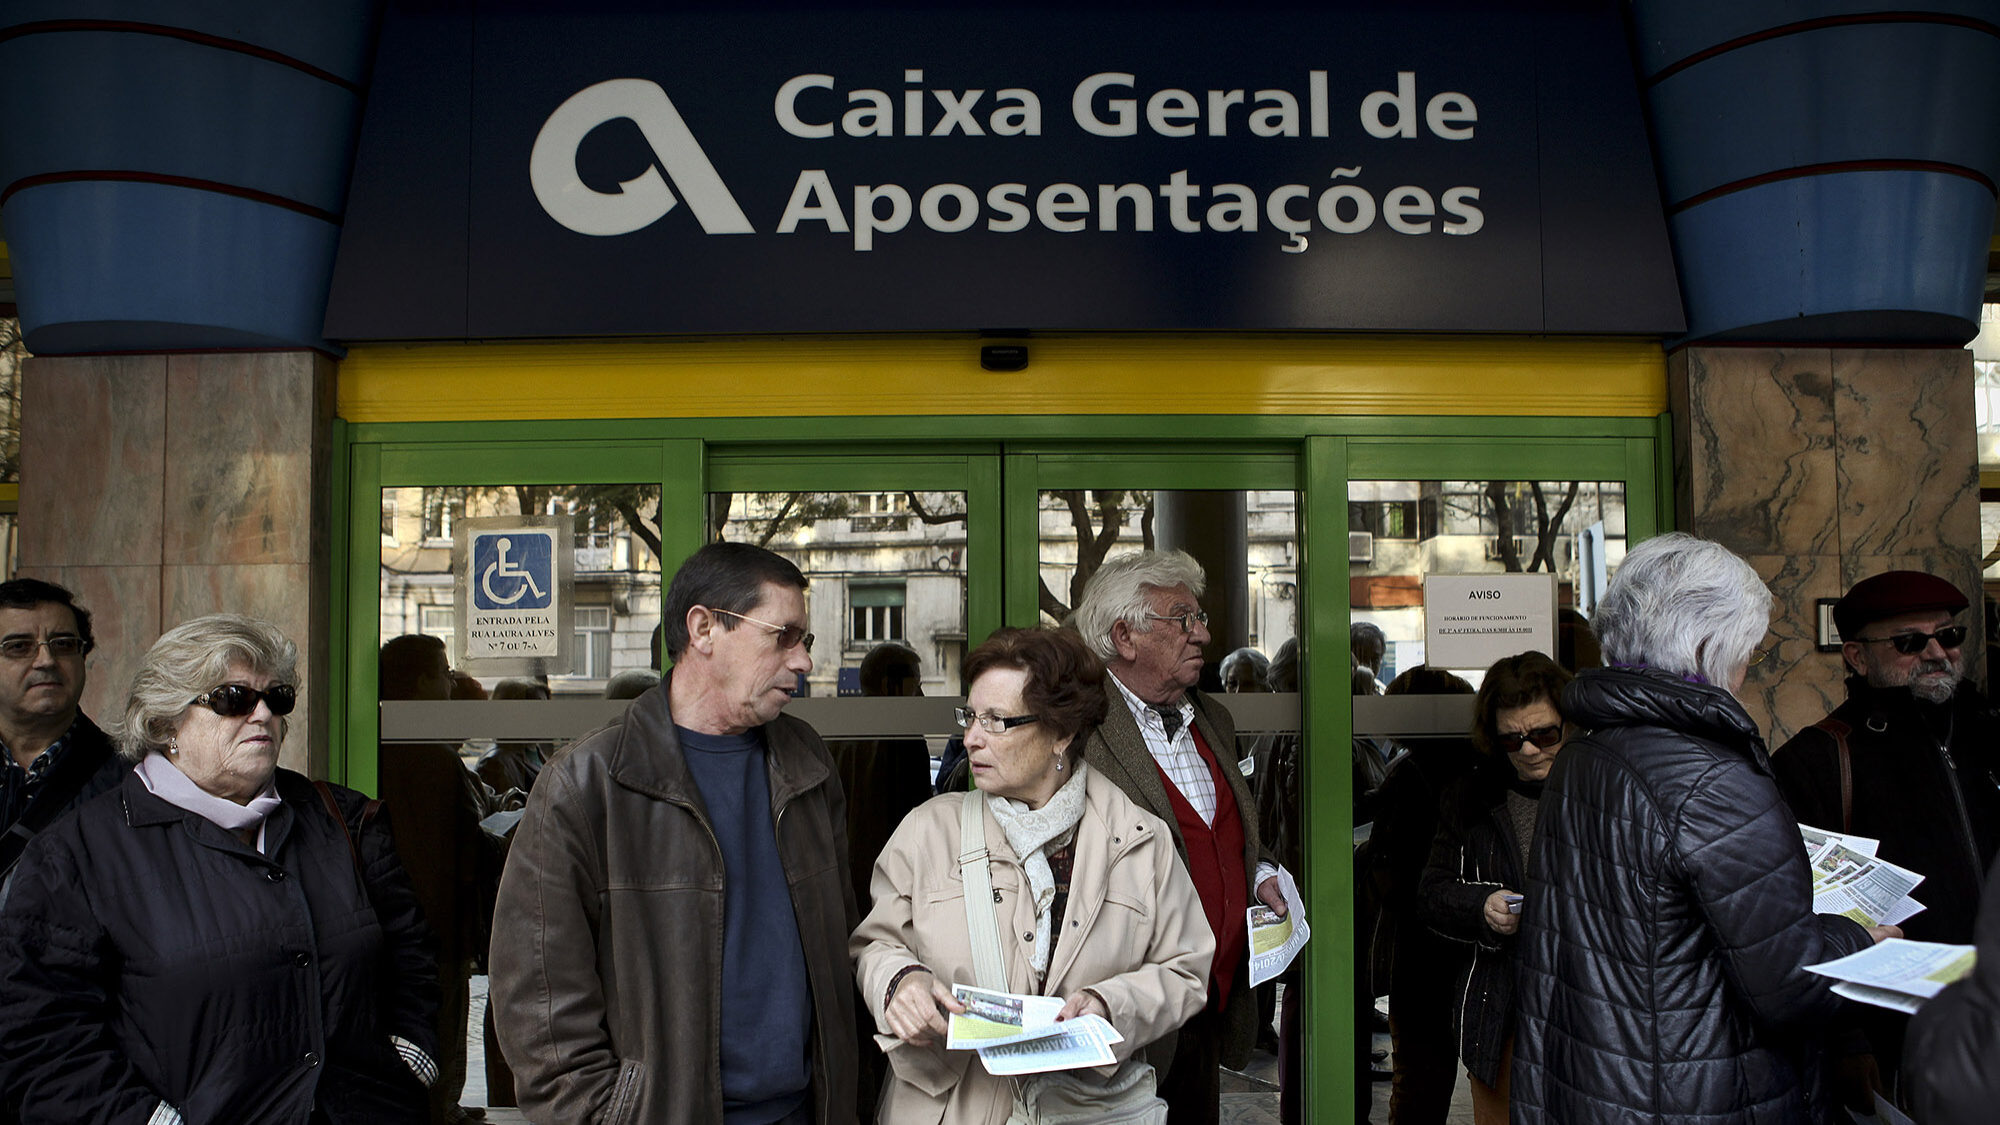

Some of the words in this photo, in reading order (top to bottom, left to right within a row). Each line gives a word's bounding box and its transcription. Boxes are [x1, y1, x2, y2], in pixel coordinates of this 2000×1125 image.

[775, 69, 1041, 139] Caixa
[1072, 71, 1329, 138] Geral
[1360, 72, 1478, 139] de
[776, 166, 1484, 253] Aposentações
[1468, 590, 1501, 600] AVISO
[477, 617, 522, 626] ENTRADA
[525, 616, 550, 625] PELA
[471, 630, 490, 639] RUA
[492, 629, 524, 638] LAURA
[525, 630, 555, 638] ALVES
[500, 641, 506, 650] 7
[507, 642, 520, 650] OU
[523, 641, 538, 650] 7-A
